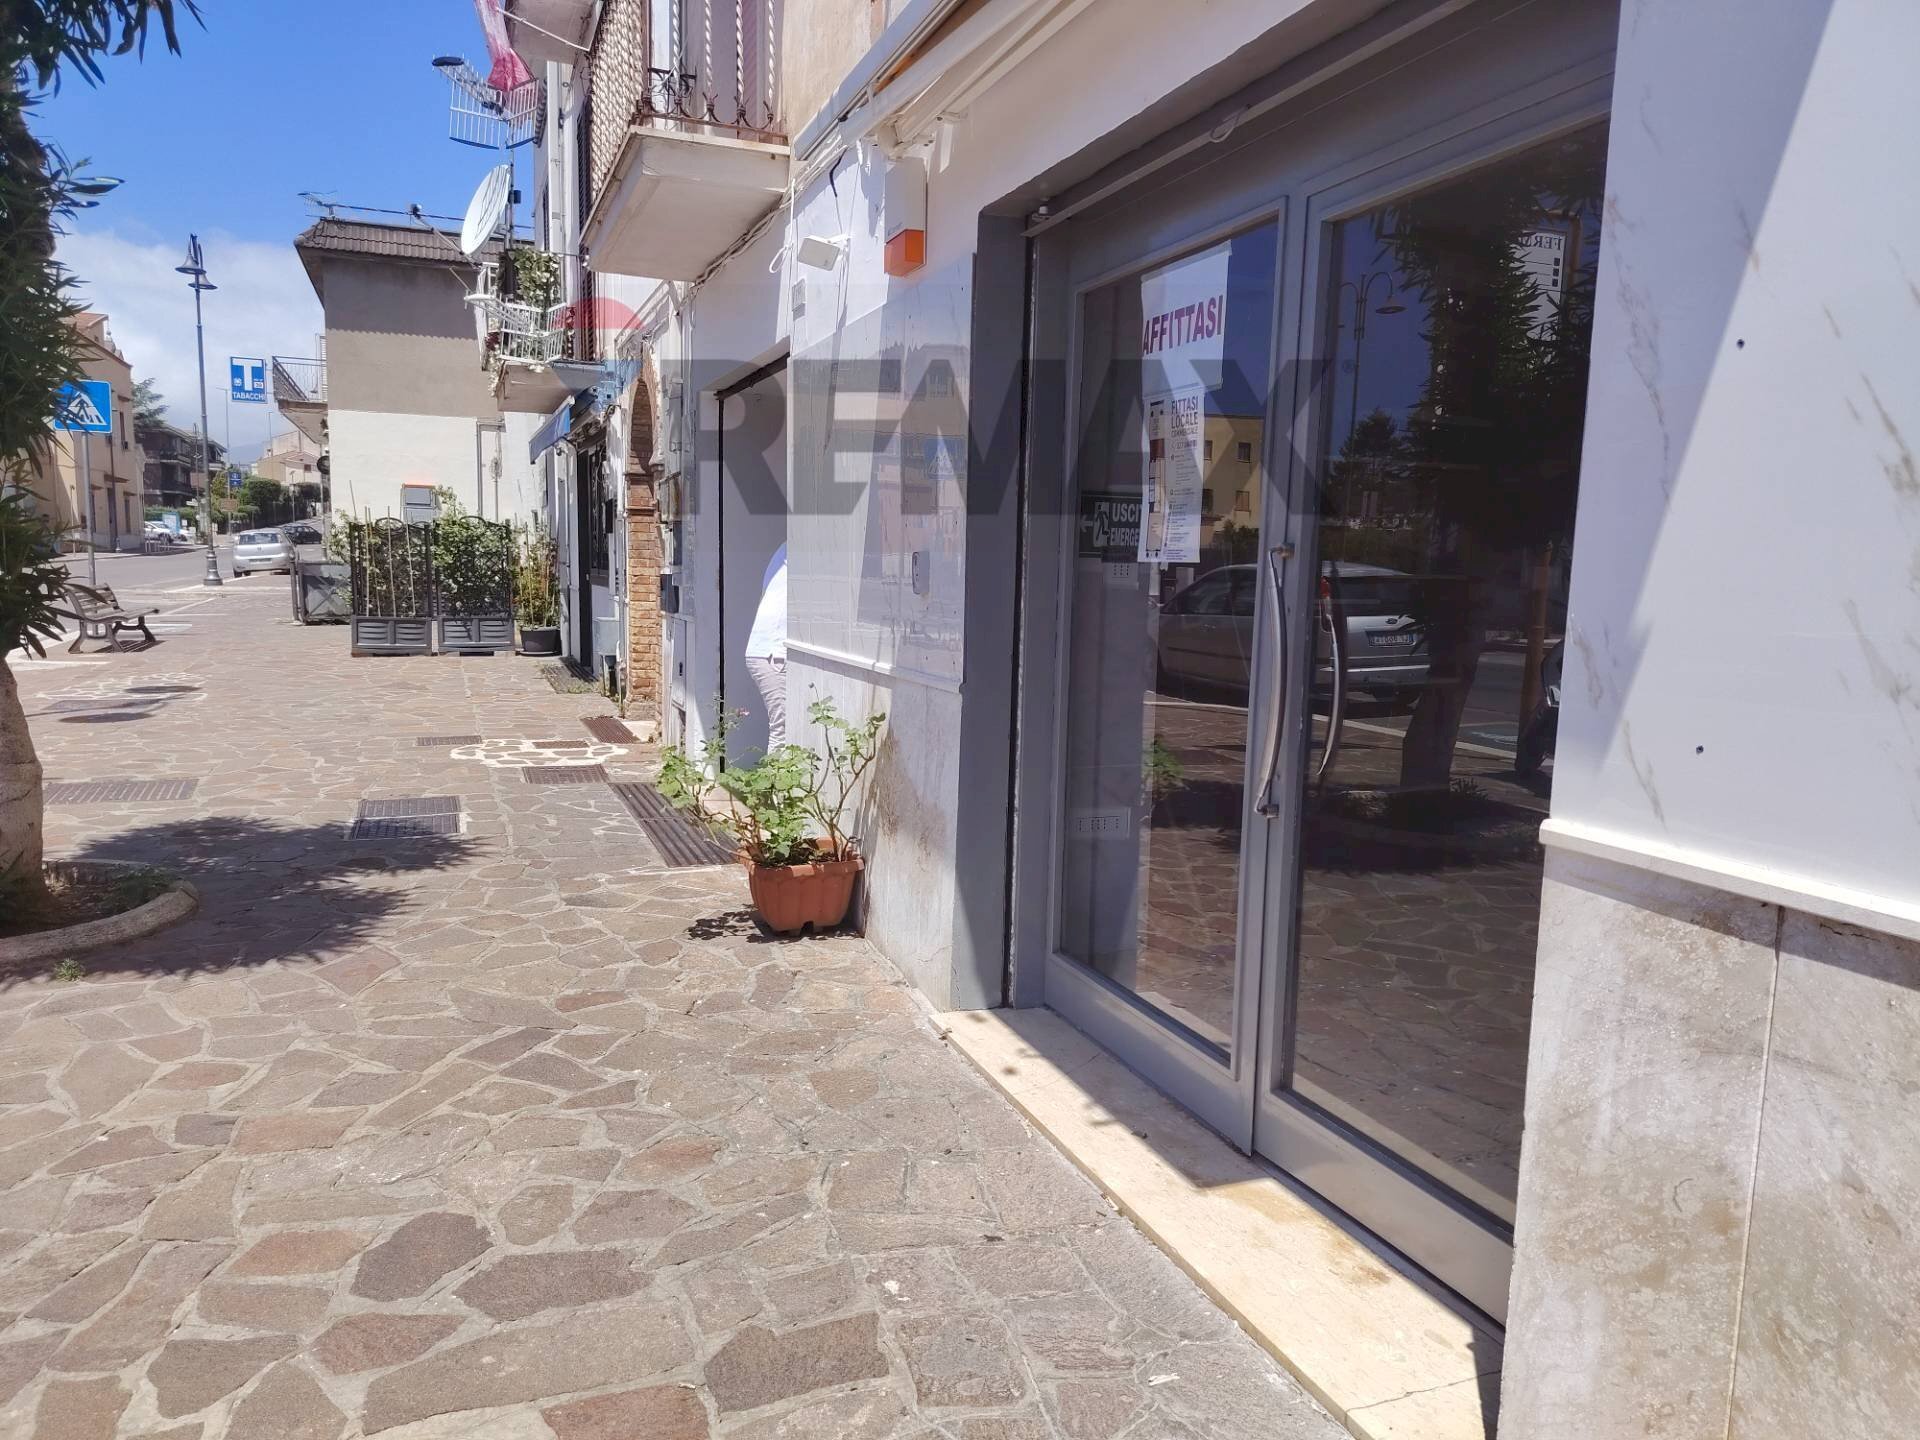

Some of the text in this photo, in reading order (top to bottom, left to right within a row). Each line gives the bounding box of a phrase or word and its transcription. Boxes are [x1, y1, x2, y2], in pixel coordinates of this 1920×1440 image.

[1143, 295, 1224, 355] AFFITTASI
[232, 360, 262, 390] T
[1171, 395, 1199, 415] FITTASI
[1171, 411, 1198, 429] LOCALE
